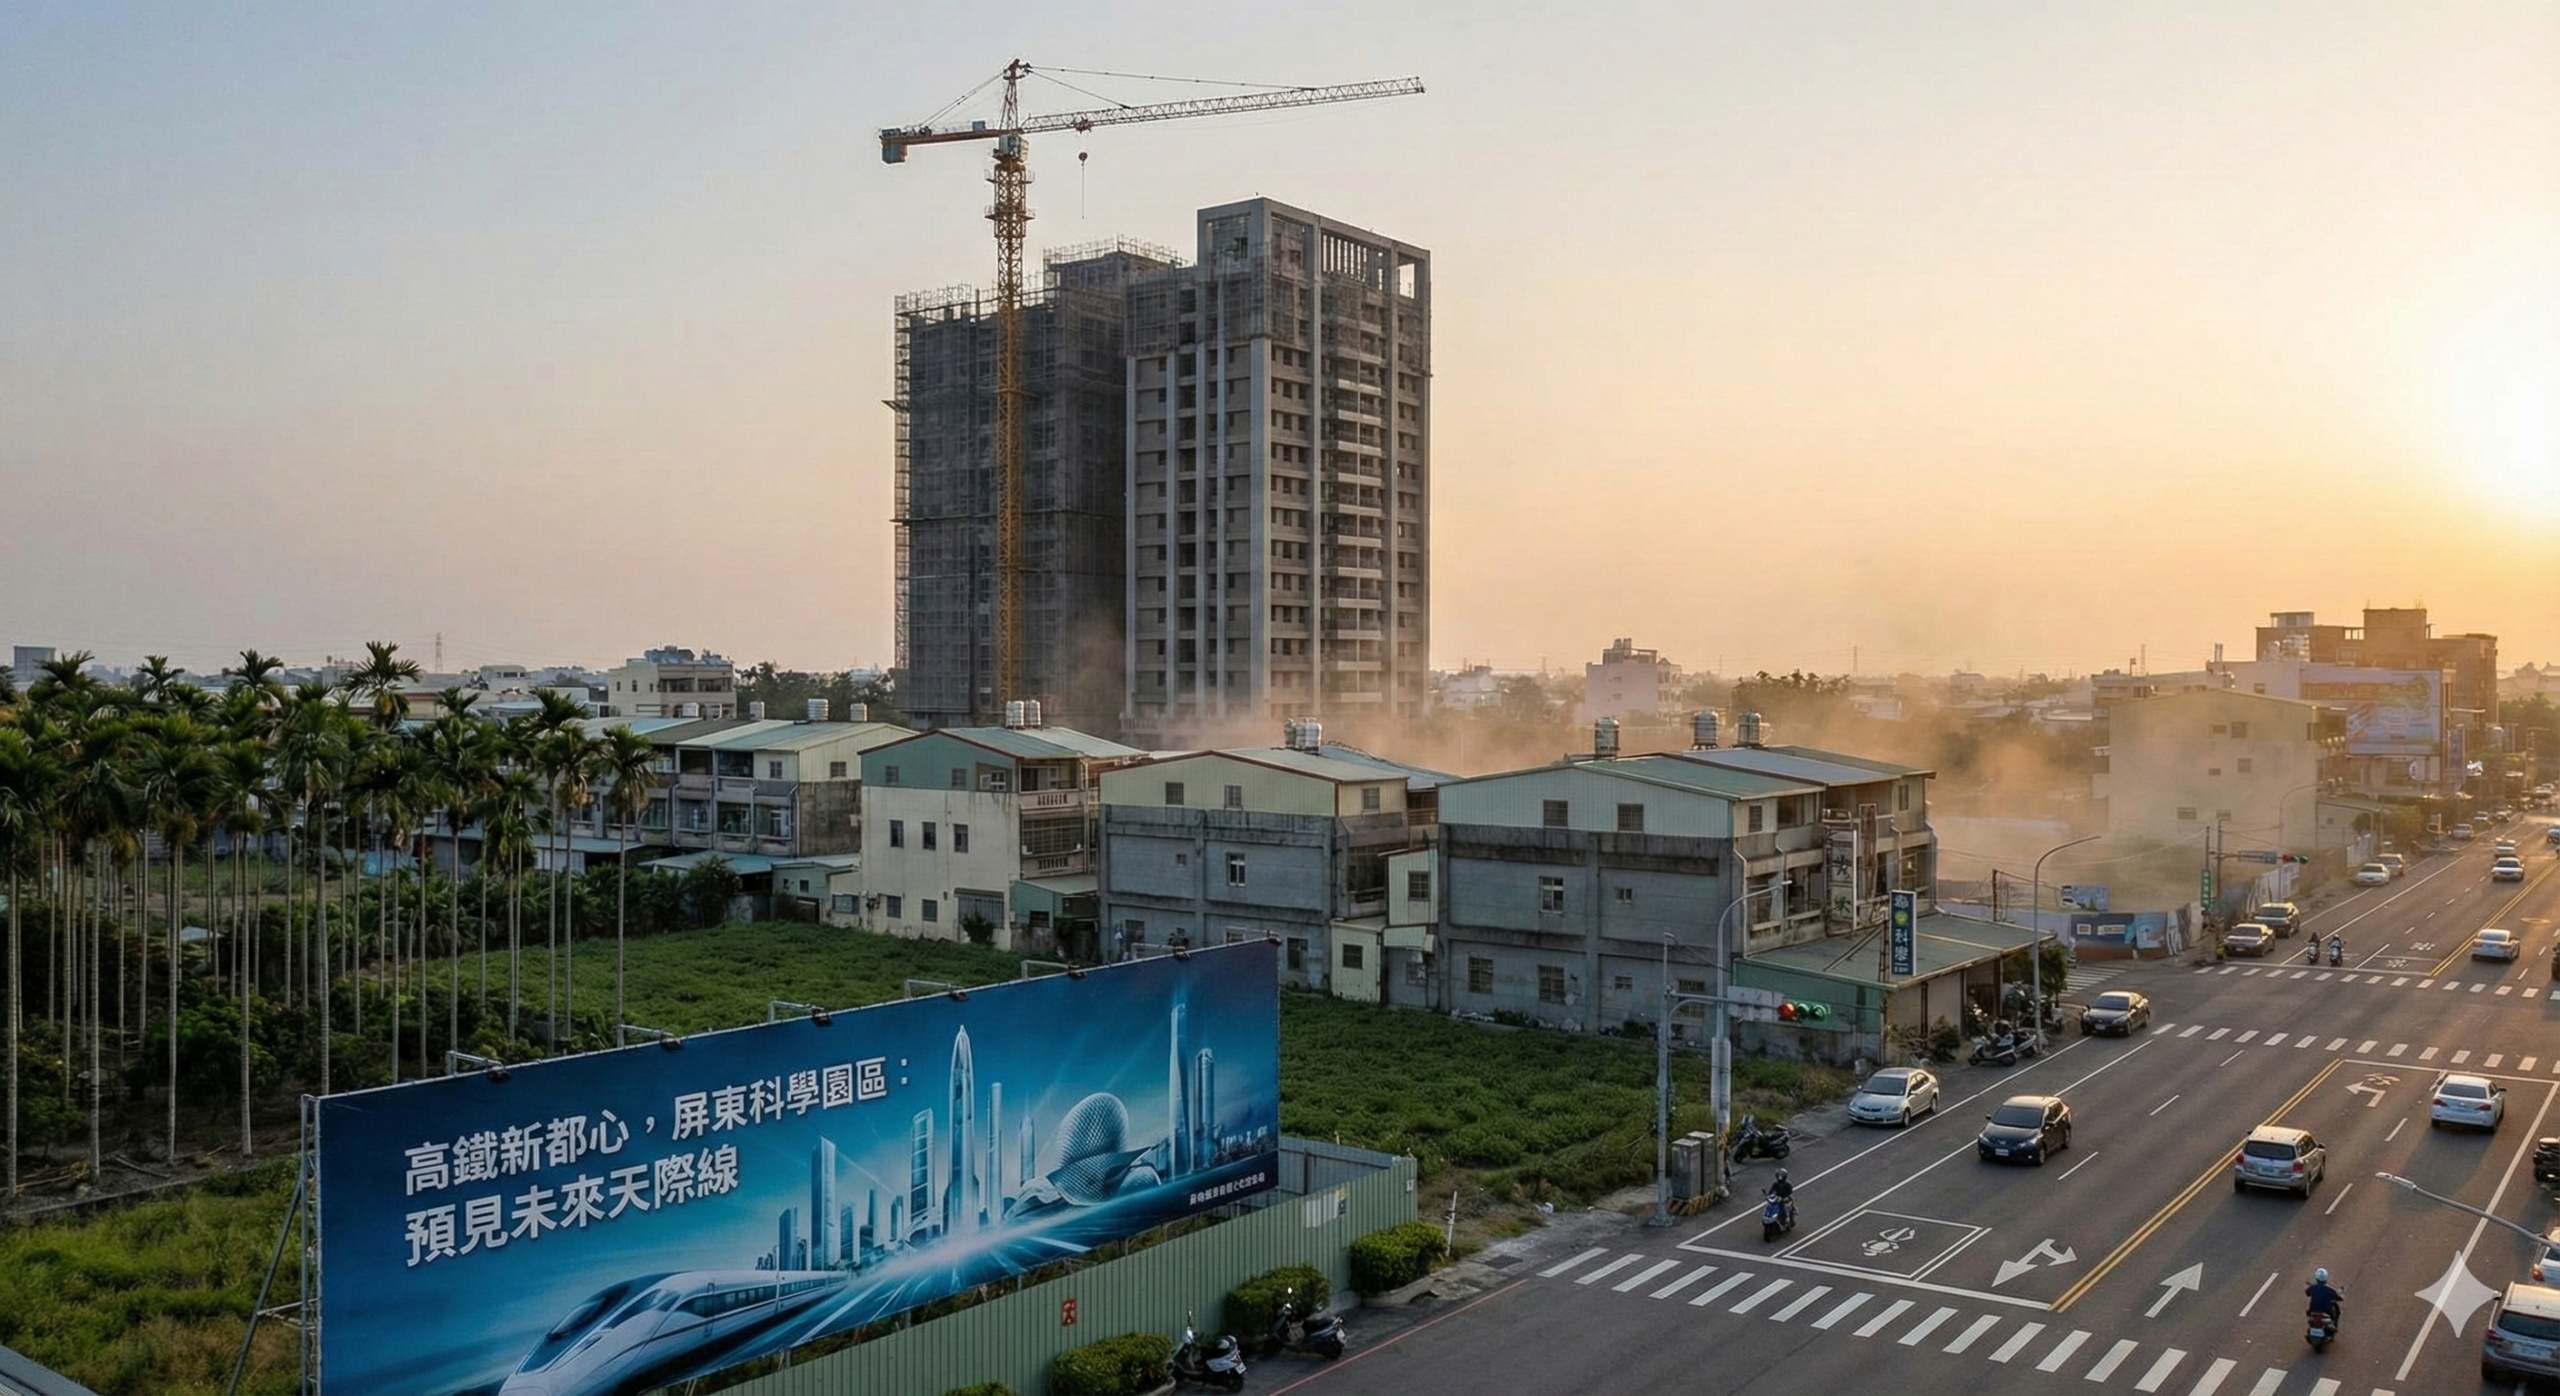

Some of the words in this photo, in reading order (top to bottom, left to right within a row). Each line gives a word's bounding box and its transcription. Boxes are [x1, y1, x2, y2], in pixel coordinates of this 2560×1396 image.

[404, 1056, 908, 1196] 高鐵新都心，屏東科學園區：
[404, 1144, 739, 1268] 預見未來天際線
